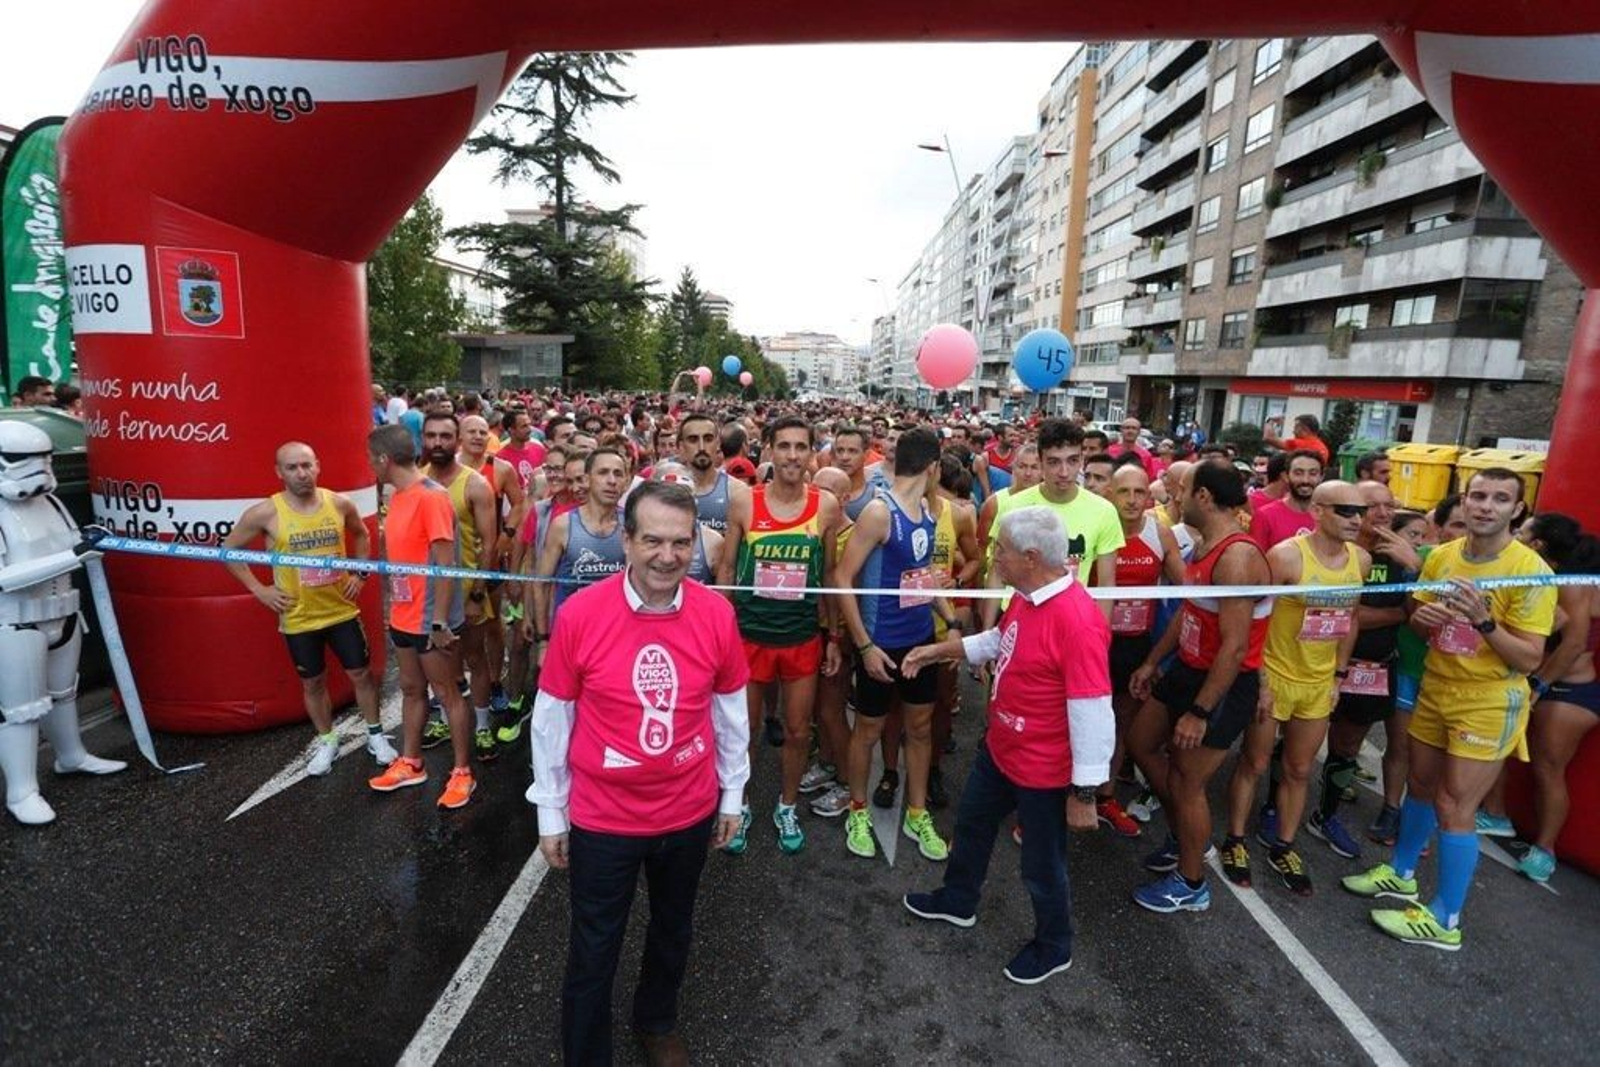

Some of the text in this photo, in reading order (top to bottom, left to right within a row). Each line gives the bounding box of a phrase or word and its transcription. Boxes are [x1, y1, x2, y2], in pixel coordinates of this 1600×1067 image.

[136, 36, 222, 81] VIGO,
[168, 75, 208, 111] de
[221, 83, 315, 121] xogo
[75, 292, 119, 313] VIGO
[131, 372, 220, 402] nunha
[117, 411, 230, 443] fermosa
[98, 478, 174, 519] VIGO,
[171, 519, 235, 548] xog
[226, 550, 272, 563] DECATHLON
[754, 544, 810, 559] BIKILA
[577, 561, 626, 574] castrelo
[1319, 619, 1336, 633] 23
[646, 652, 661, 663] VI
[639, 668, 670, 678] VIGO
